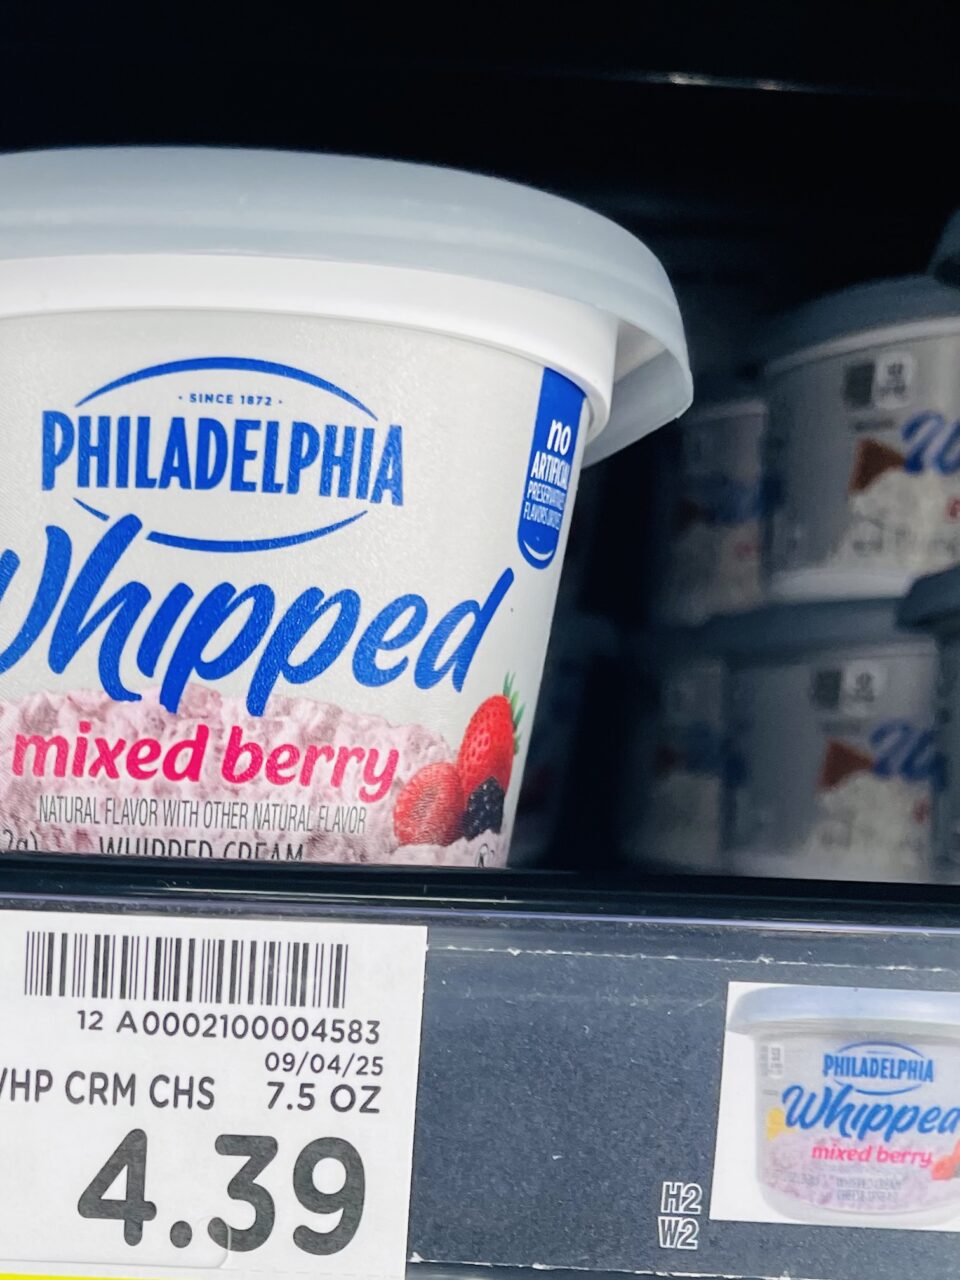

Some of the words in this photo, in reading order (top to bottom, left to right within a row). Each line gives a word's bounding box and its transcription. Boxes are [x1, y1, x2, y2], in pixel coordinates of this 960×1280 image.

[189, 393, 234, 405] SINCE
[239, 395, 273, 406] 1872
[546, 419, 571, 456] no
[41, 410, 404, 506] PHILADELPHIA
[10, 721, 214, 784] mixed
[220, 720, 401, 805] berry
[40, 795, 101, 825] NATURAL
[105, 798, 158, 828] FLAVOR
[163, 800, 199, 828] WITH
[203, 802, 249, 831] OTHER
[252, 804, 317, 832] NATURAL
[319, 806, 367, 835] FLAVOR
[76, 1009, 104, 1033] 12
[116, 1010, 381, 1045] A0002100004583
[264, 1051, 384, 1078] 09/04/25
[822, 1053, 934, 1083] PHILADELPHIA
[64, 1070, 137, 1107] CRM
[148, 1074, 217, 1111] CHS
[265, 1081, 315, 1112] 7.5
[329, 1083, 382, 1115] OZ
[811, 1145, 873, 1163] mixed
[876, 1145, 933, 1168] berry
[77, 1127, 368, 1257] 4.39
[660, 1181, 702, 1215] H2
[657, 1216, 699, 1250] W2
